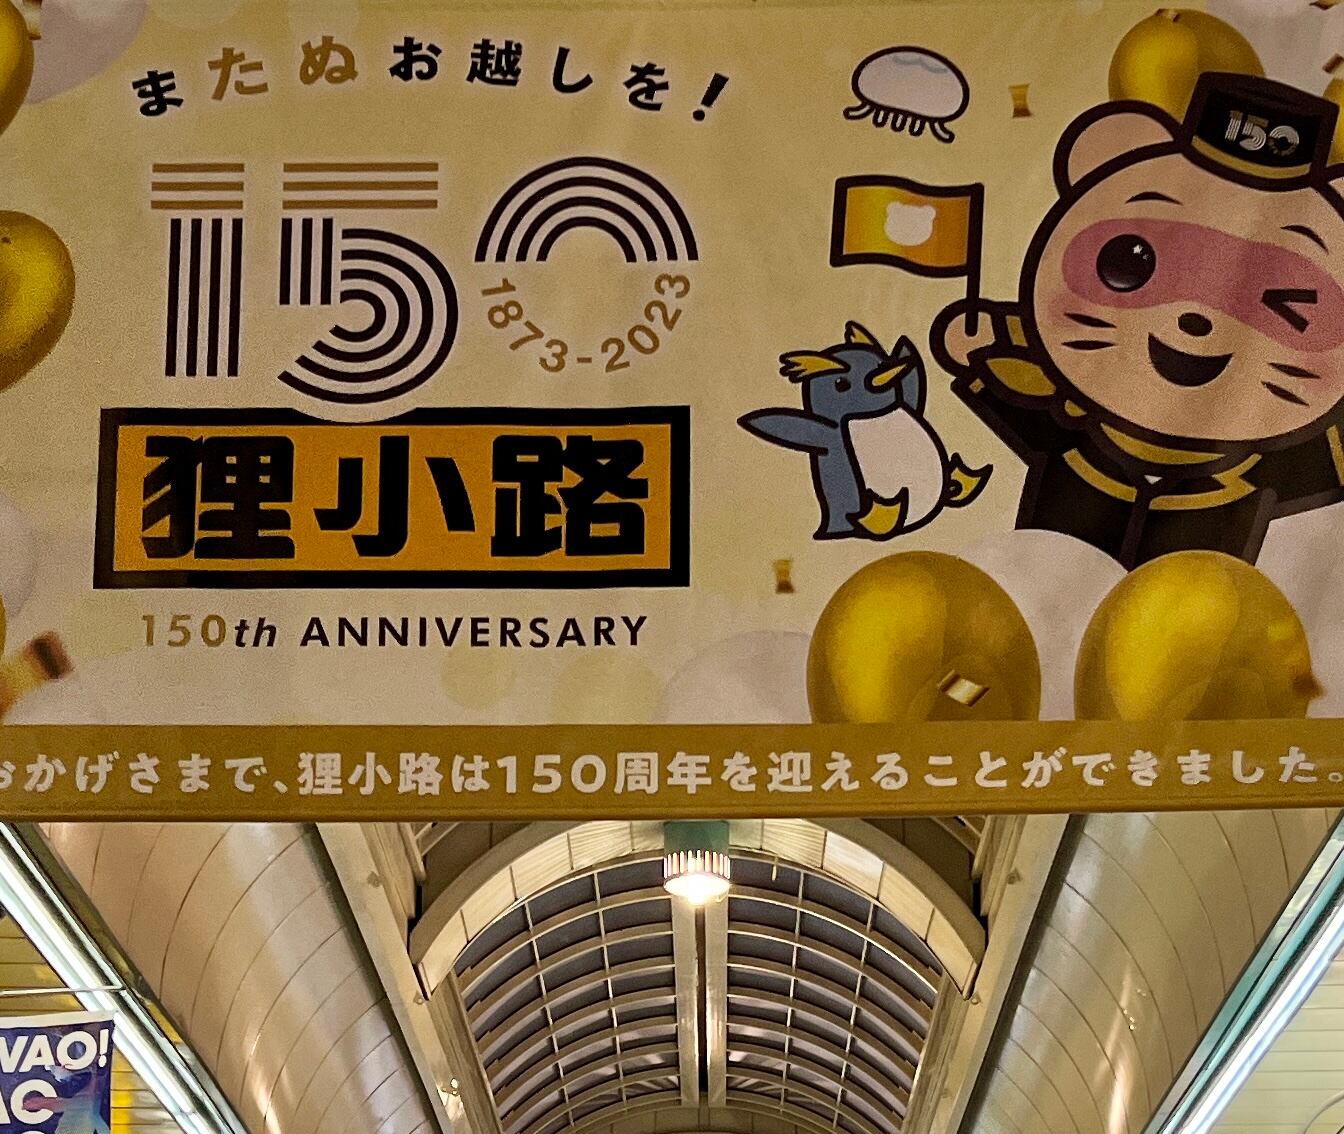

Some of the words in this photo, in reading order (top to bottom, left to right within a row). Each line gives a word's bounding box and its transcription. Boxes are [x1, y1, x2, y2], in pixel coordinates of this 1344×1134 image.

[149, 156, 700, 405] 150
[479, 270, 695, 376] 1873-2023
[140, 433, 651, 562] 狸小路
[141, 611, 278, 650] 150th
[301, 613, 648, 650] ANNIVERSARY
